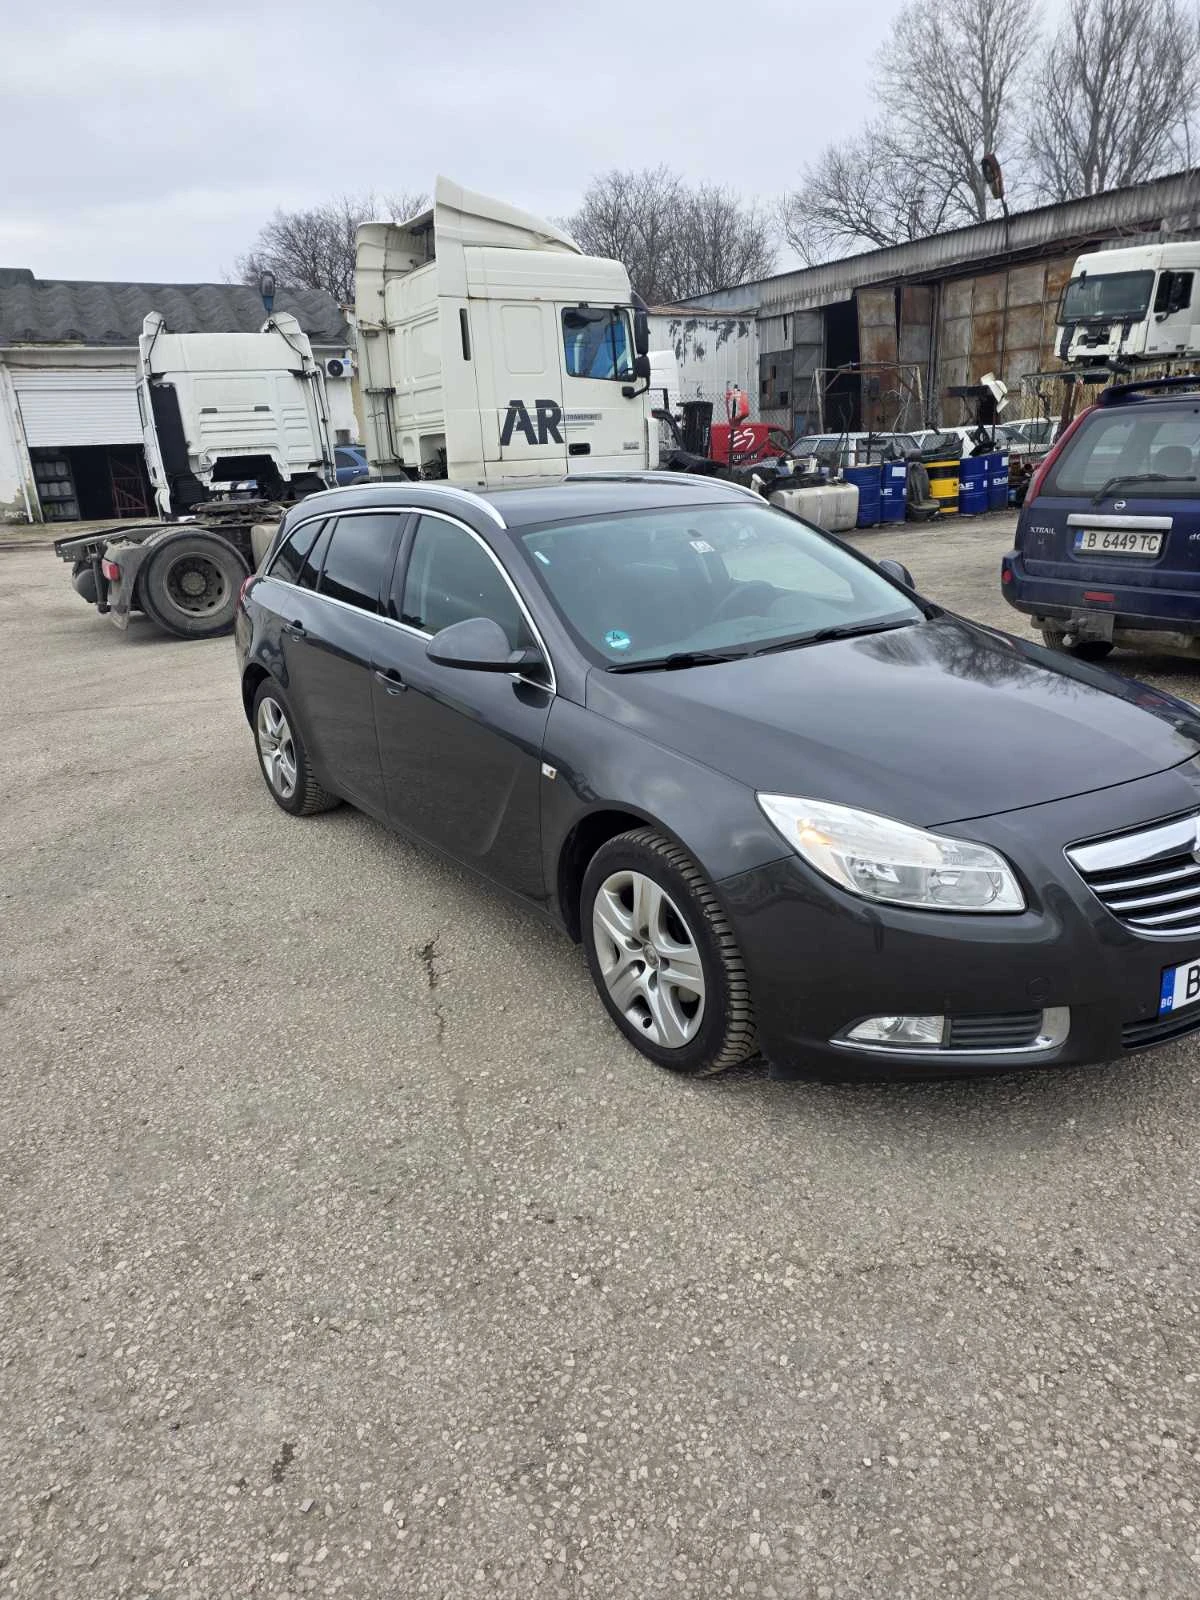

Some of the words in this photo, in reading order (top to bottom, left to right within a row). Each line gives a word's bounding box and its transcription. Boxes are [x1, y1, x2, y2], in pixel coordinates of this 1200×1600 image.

[500, 399, 565, 446] AR
[1087, 532, 1097, 548] B
[1102, 533, 1137, 550] 6449
[1140, 535, 1159, 551] TC
[1161, 996, 1172, 1008] BG
